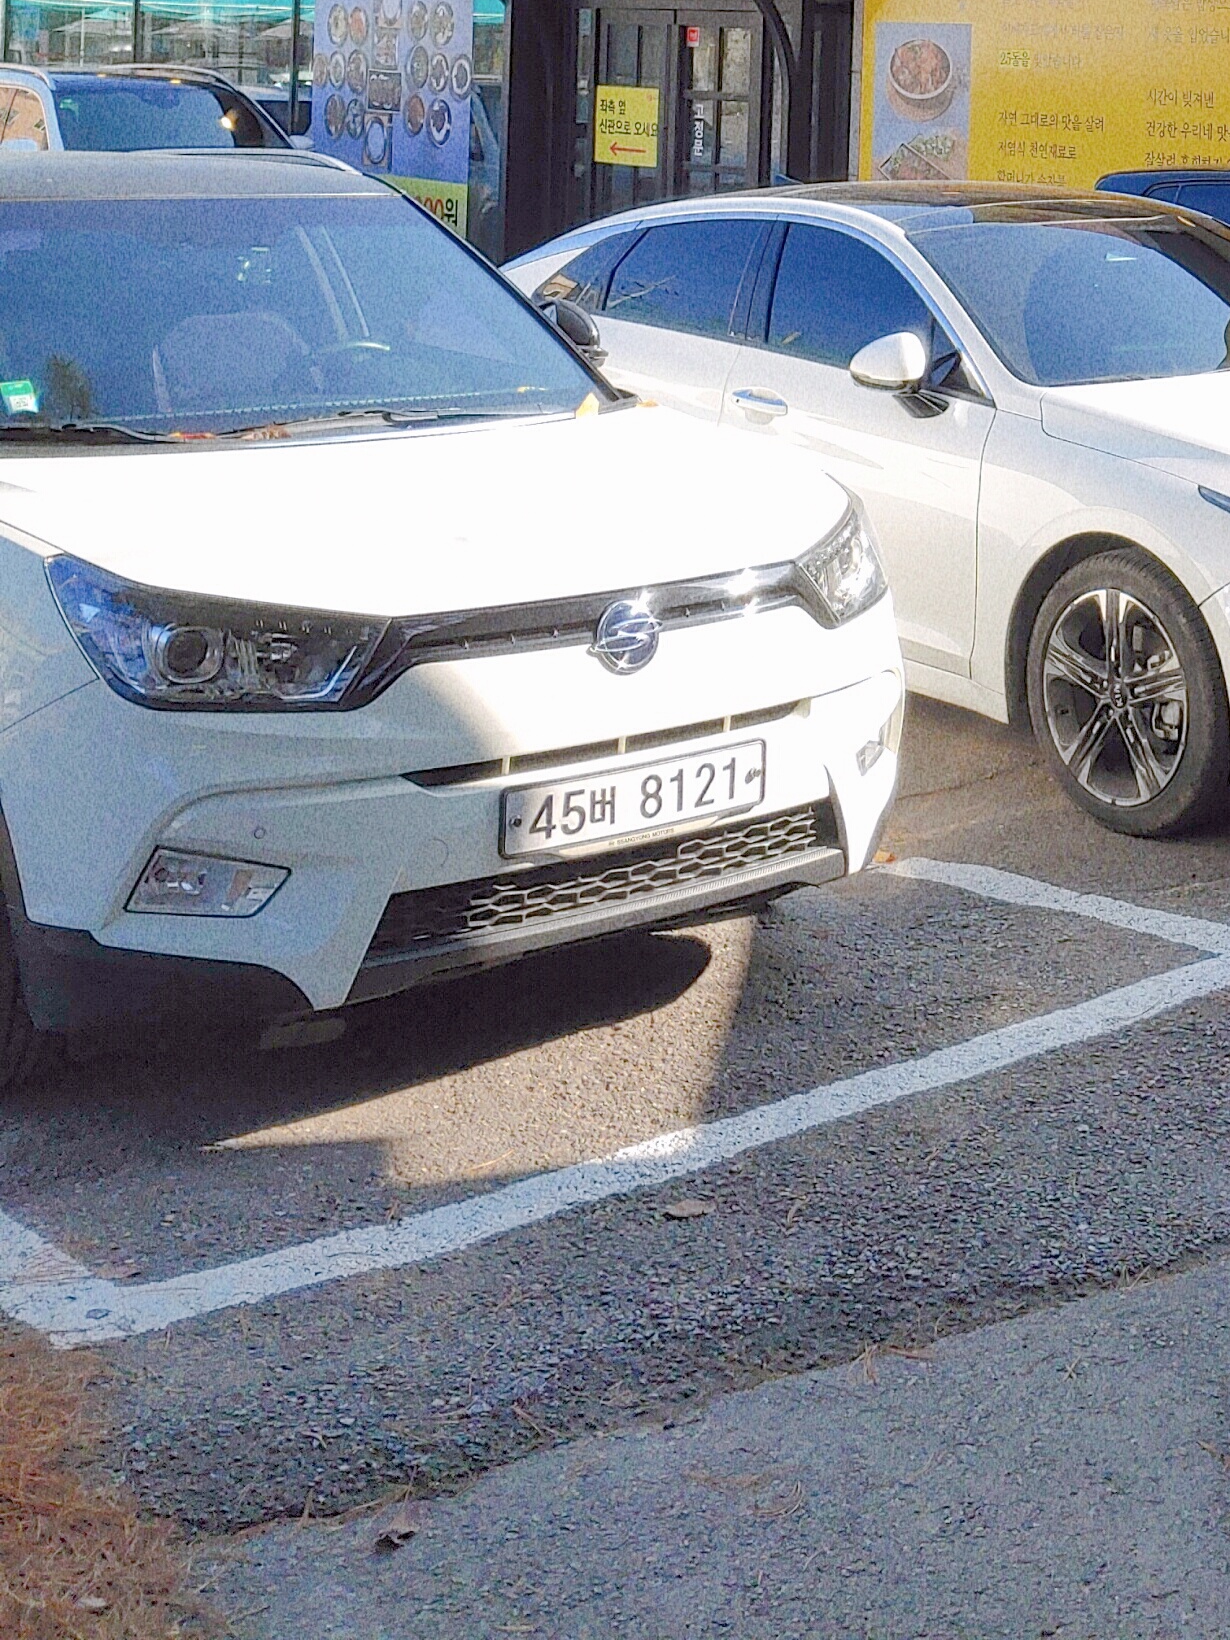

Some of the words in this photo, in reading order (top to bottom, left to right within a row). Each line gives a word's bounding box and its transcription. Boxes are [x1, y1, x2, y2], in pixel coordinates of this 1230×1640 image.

[600, 118, 632, 135] 신관으로
[528, 785, 617, 840] 45버
[639, 756, 737, 819] 8121
